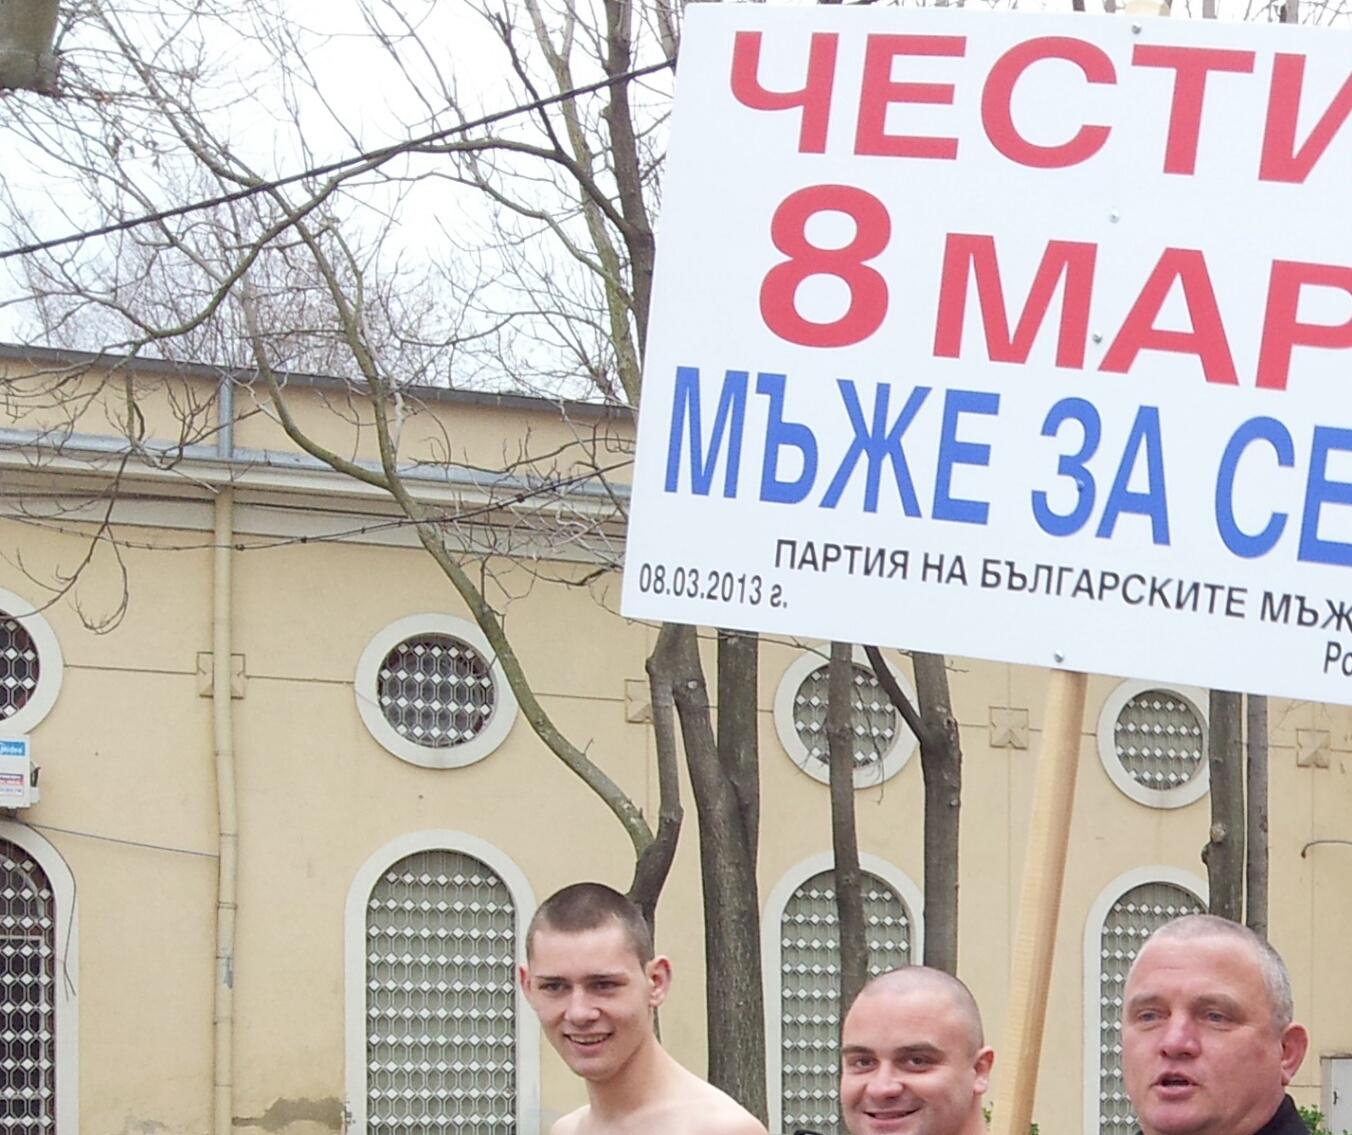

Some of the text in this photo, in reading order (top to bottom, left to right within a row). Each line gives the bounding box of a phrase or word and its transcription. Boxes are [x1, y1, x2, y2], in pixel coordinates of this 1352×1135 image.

[760, 184, 892, 348] 8
[663, 365, 1002, 526] МЪЖЕ
[1030, 395, 1171, 546] ЗА
[639, 563, 788, 608] 08.03.2013 г.
[775, 539, 909, 580] ПАРТИЯ
[922, 553, 967, 585] НА
[981, 559, 1247, 618] БЪЛГАРСКИТЕ
